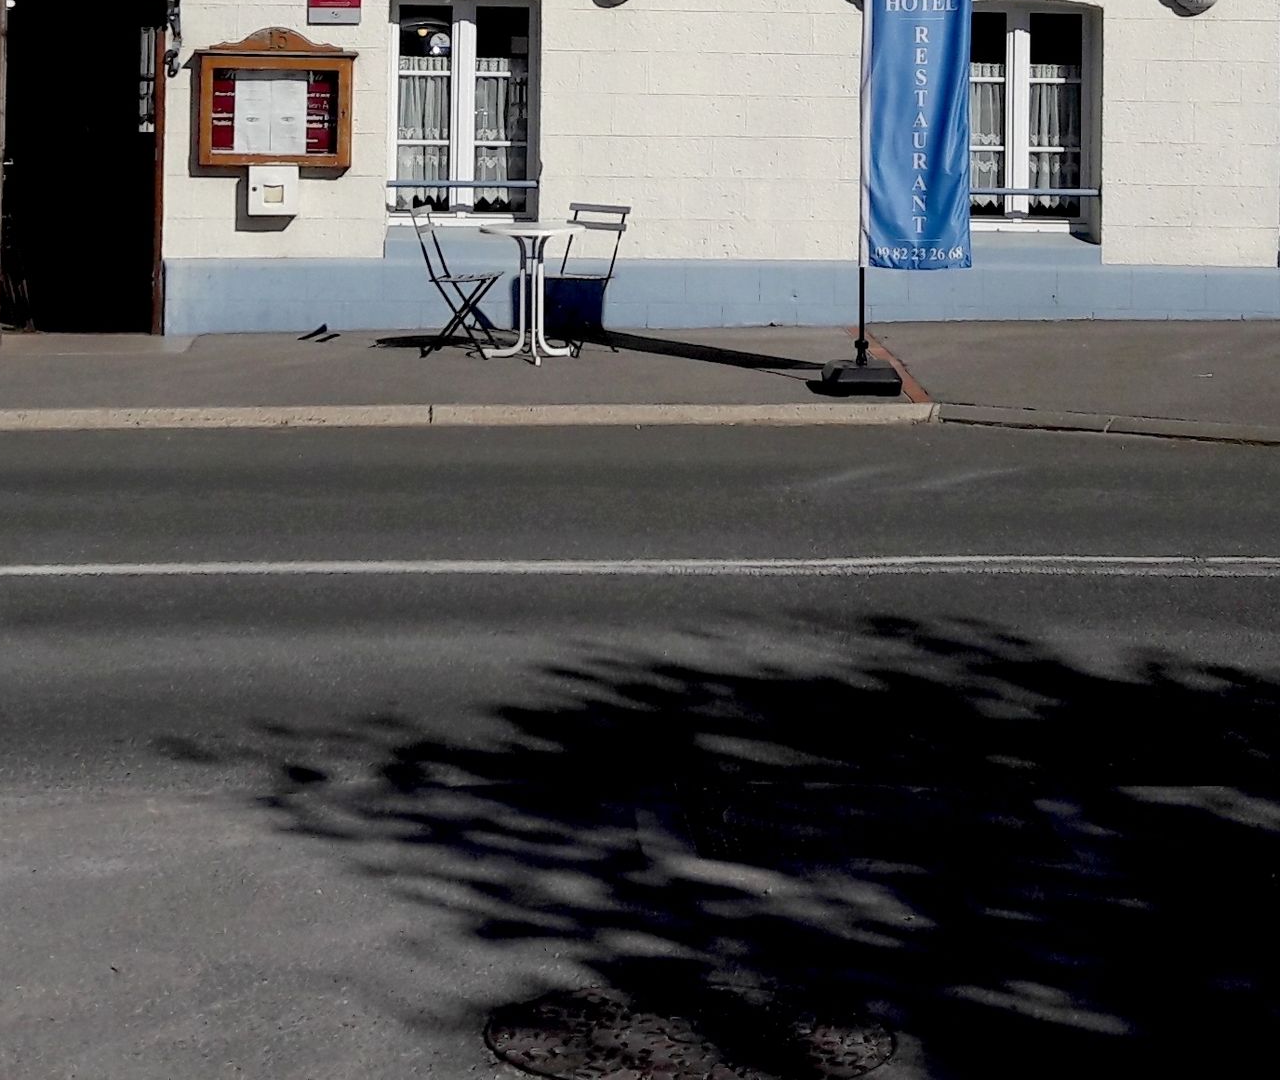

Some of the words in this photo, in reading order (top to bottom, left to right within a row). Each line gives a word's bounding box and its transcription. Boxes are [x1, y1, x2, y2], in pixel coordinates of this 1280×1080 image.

[268, 30, 287, 49] 15
[912, 25, 930, 234] RESTAURANT
[893, 247, 908, 259] 82
[911, 248, 926, 260] 23
[930, 248, 945, 260] 26
[948, 246, 964, 260] 68
